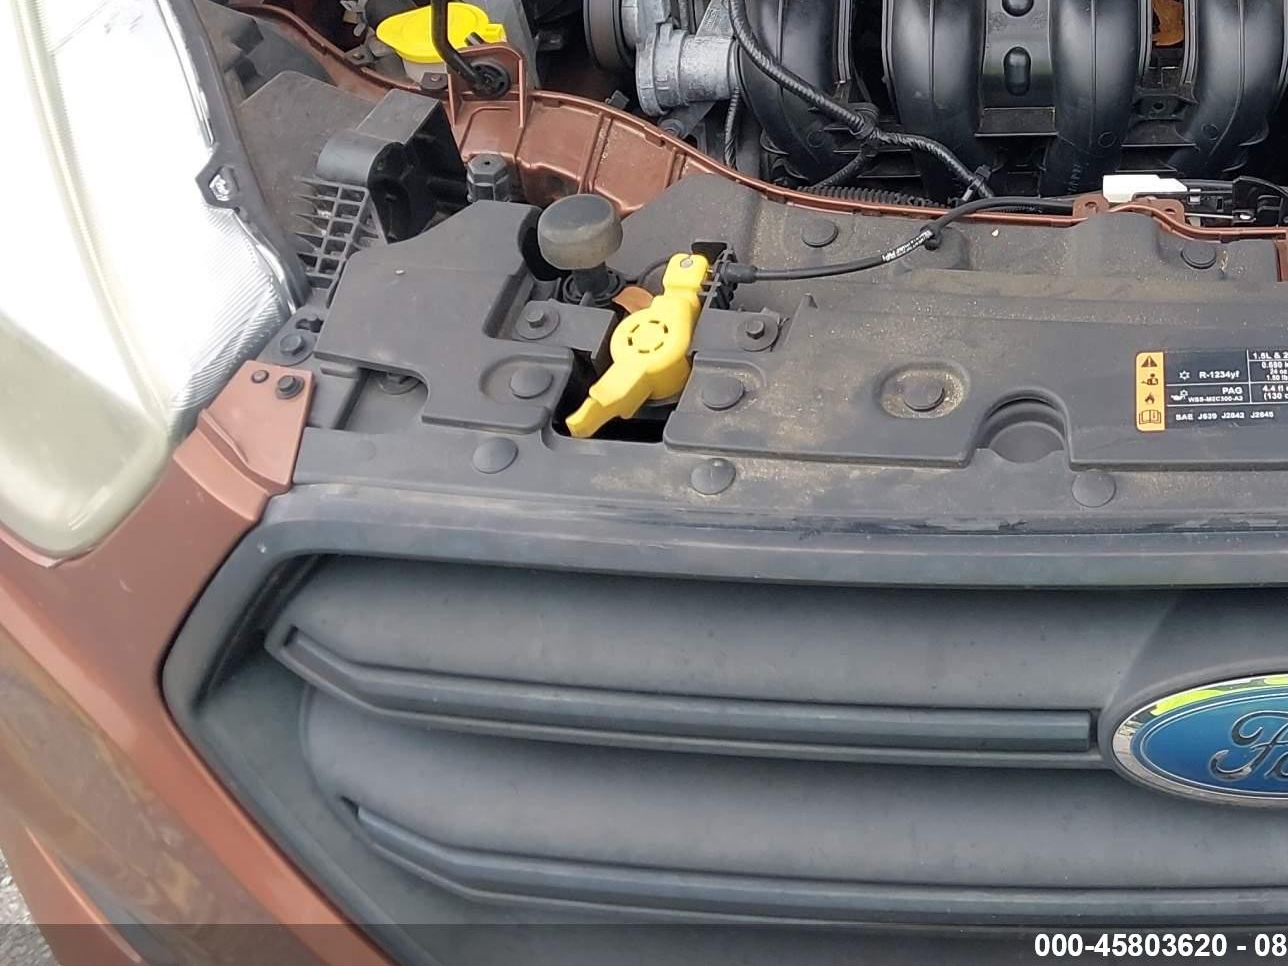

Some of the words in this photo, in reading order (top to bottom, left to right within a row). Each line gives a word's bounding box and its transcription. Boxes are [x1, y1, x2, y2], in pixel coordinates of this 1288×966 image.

[1198, 370, 1240, 380] R-1234yf
[1221, 386, 1243, 395] PAG
[1262, 384, 1277, 392] 4.4
[1263, 392, 1283, 400] (130
